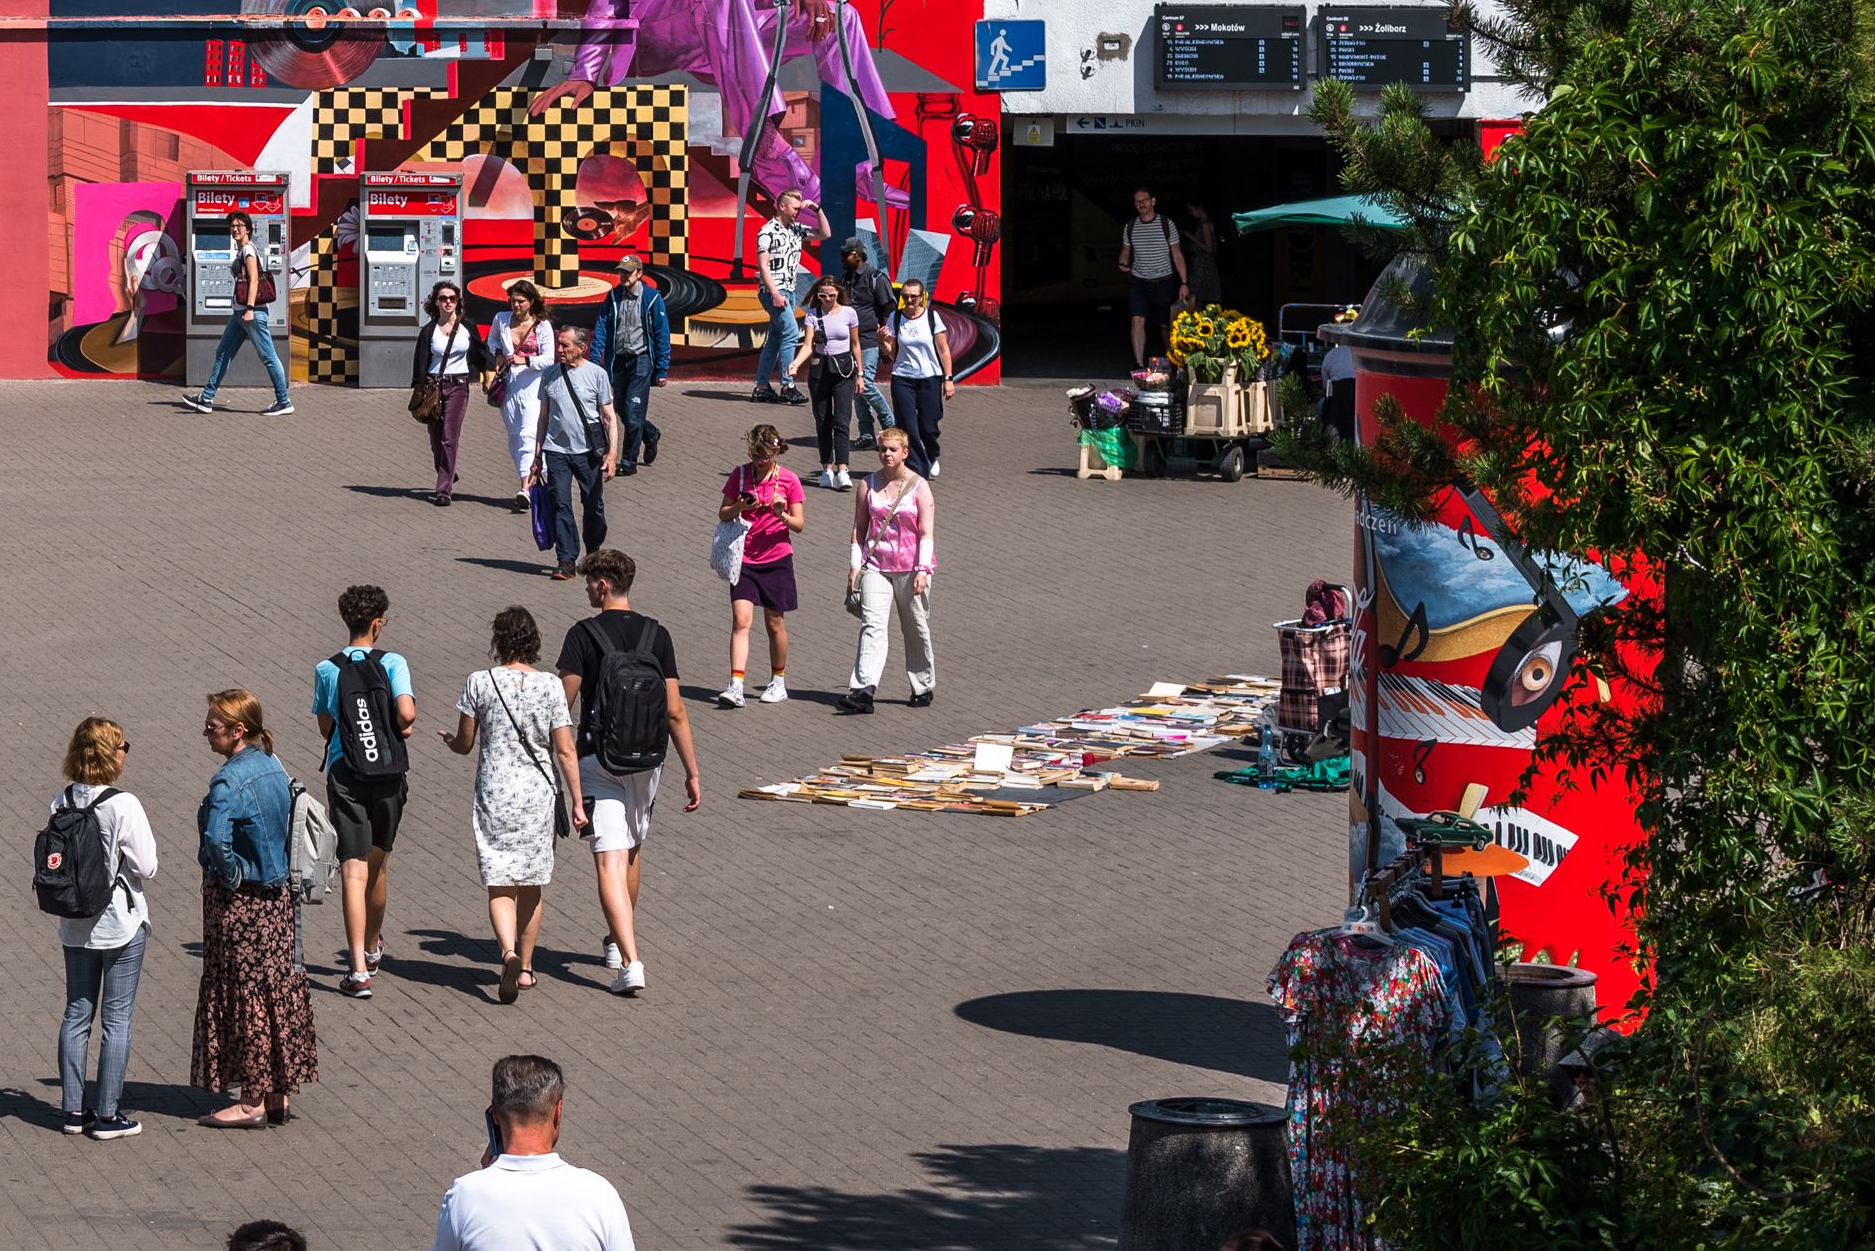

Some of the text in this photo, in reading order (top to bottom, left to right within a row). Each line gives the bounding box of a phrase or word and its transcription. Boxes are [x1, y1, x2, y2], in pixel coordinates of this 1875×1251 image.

[1211, 23, 1245, 32] Mokotów
[1375, 22, 1406, 33] Żoliborz
[197, 174, 220, 183] Bilety
[226, 174, 252, 183] Tickets
[370, 175, 393, 184] Bilety
[398, 175, 426, 183] Tickets
[197, 192, 235, 207] Bilety
[370, 193, 408, 208] Bilety
[356, 697, 379, 762] adidas
